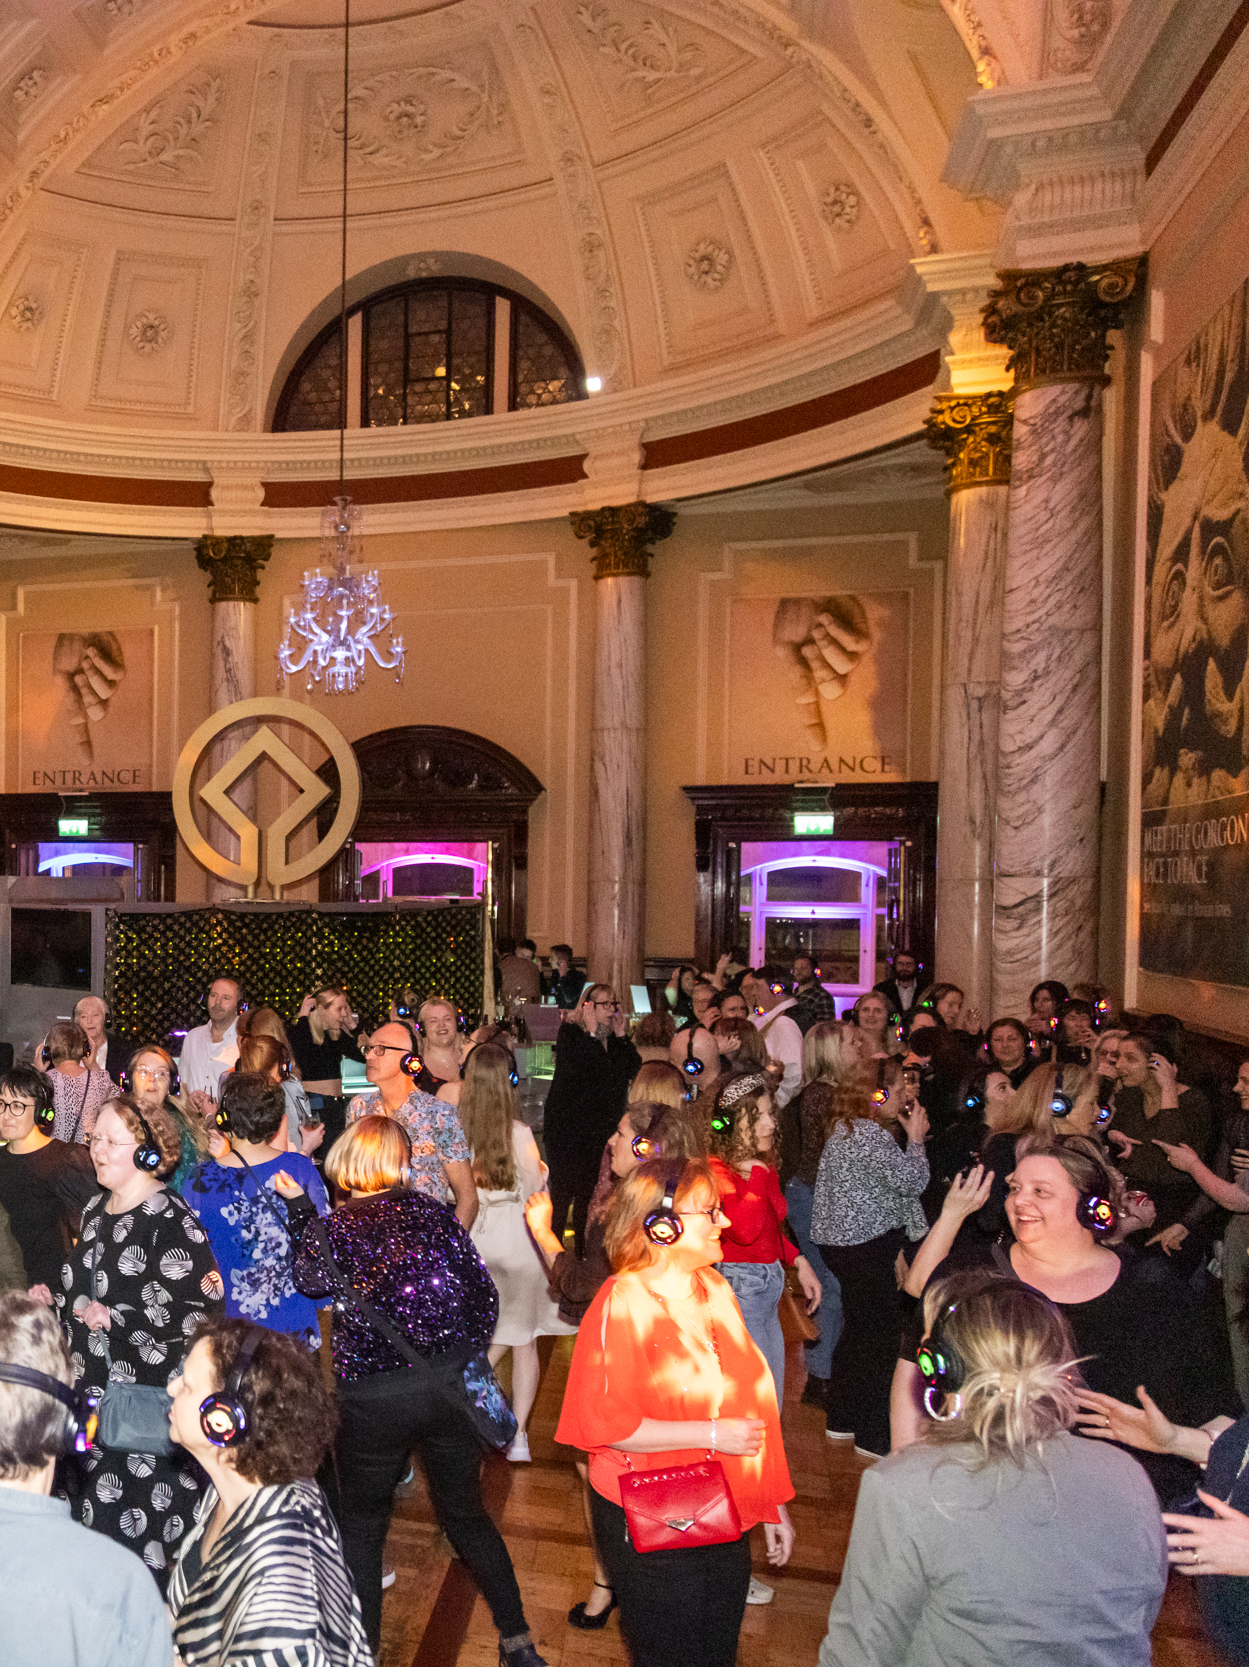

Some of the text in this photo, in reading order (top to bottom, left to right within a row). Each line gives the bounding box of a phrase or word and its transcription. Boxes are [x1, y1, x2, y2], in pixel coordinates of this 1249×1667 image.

[32, 768, 141, 786] ENTRANCE
[743, 755, 892, 776] ENTRANCE
[1144, 825, 1167, 852] MEET
[1169, 823, 1190, 850] THE
[1166, 857, 1180, 883] TO
